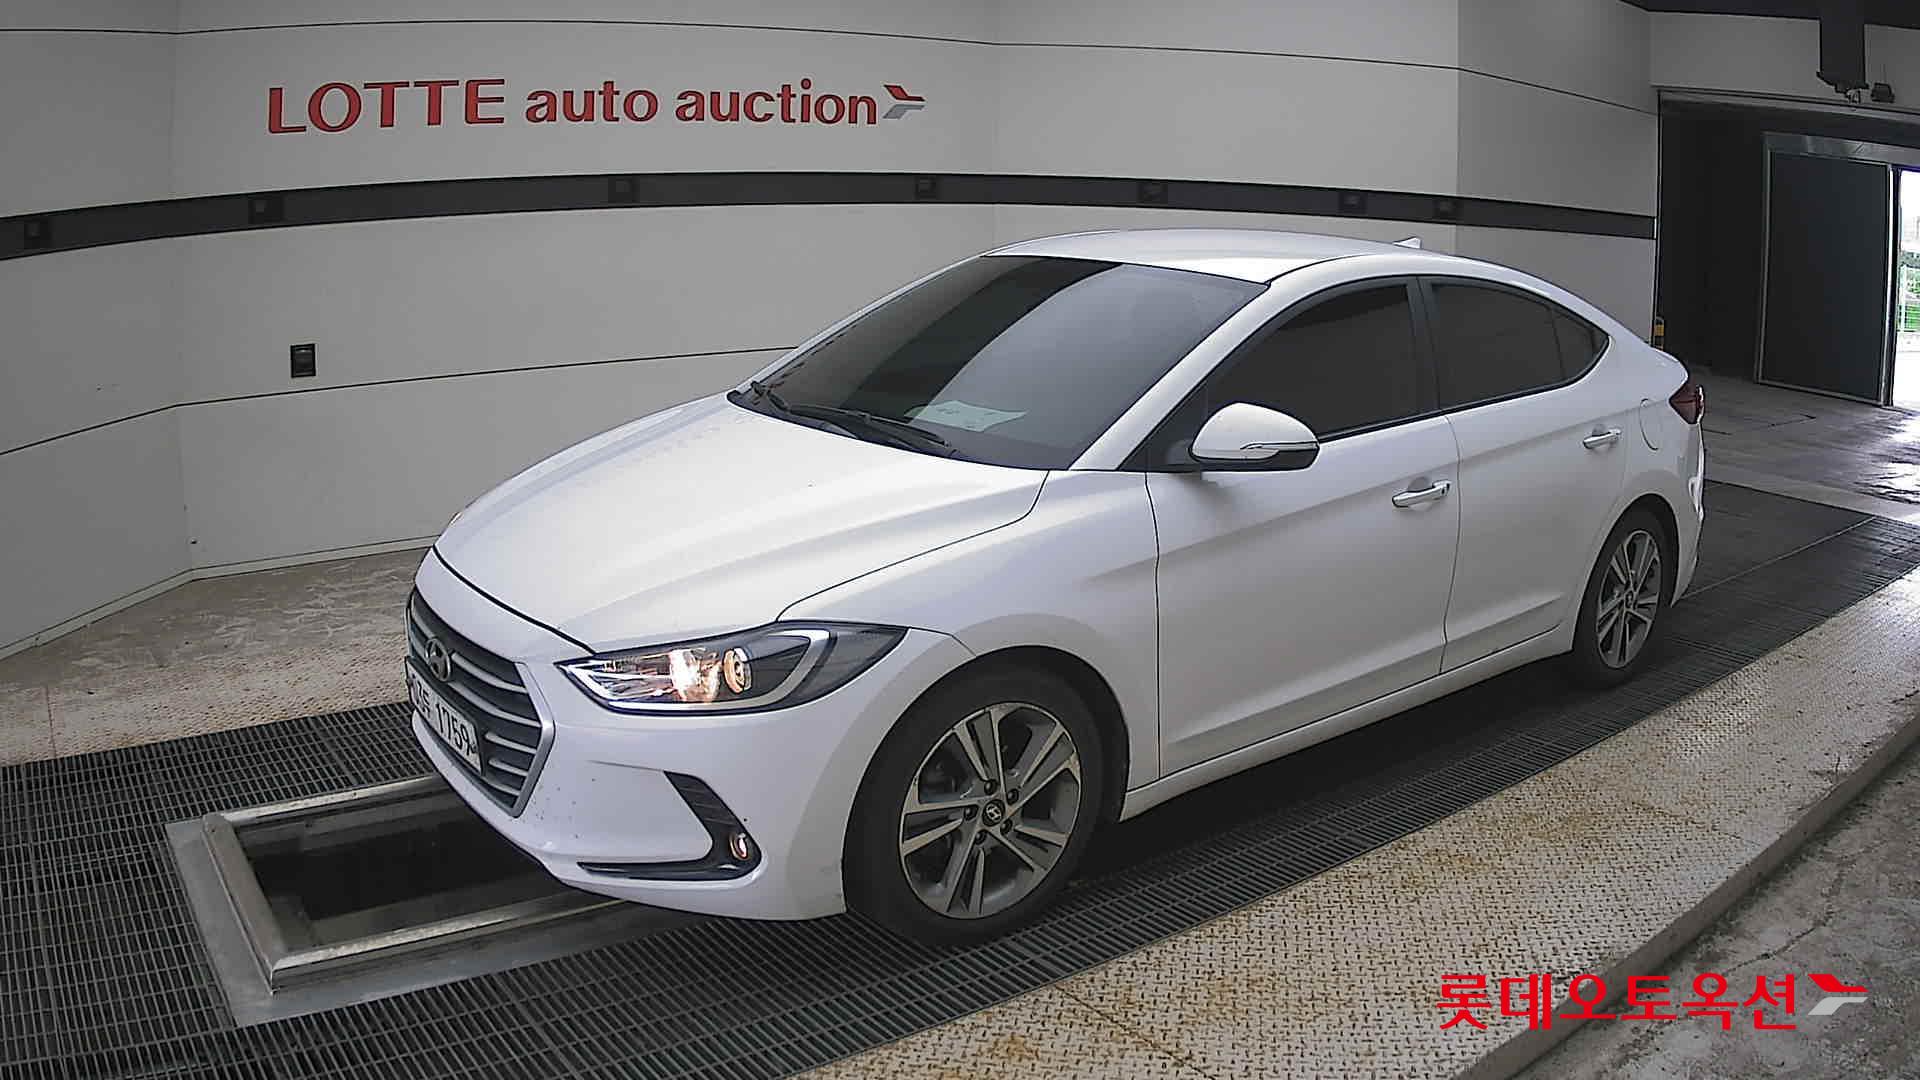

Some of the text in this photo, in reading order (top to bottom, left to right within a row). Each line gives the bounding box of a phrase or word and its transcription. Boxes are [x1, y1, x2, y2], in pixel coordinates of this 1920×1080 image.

[267, 79, 878, 134] LOTTE auto auction
